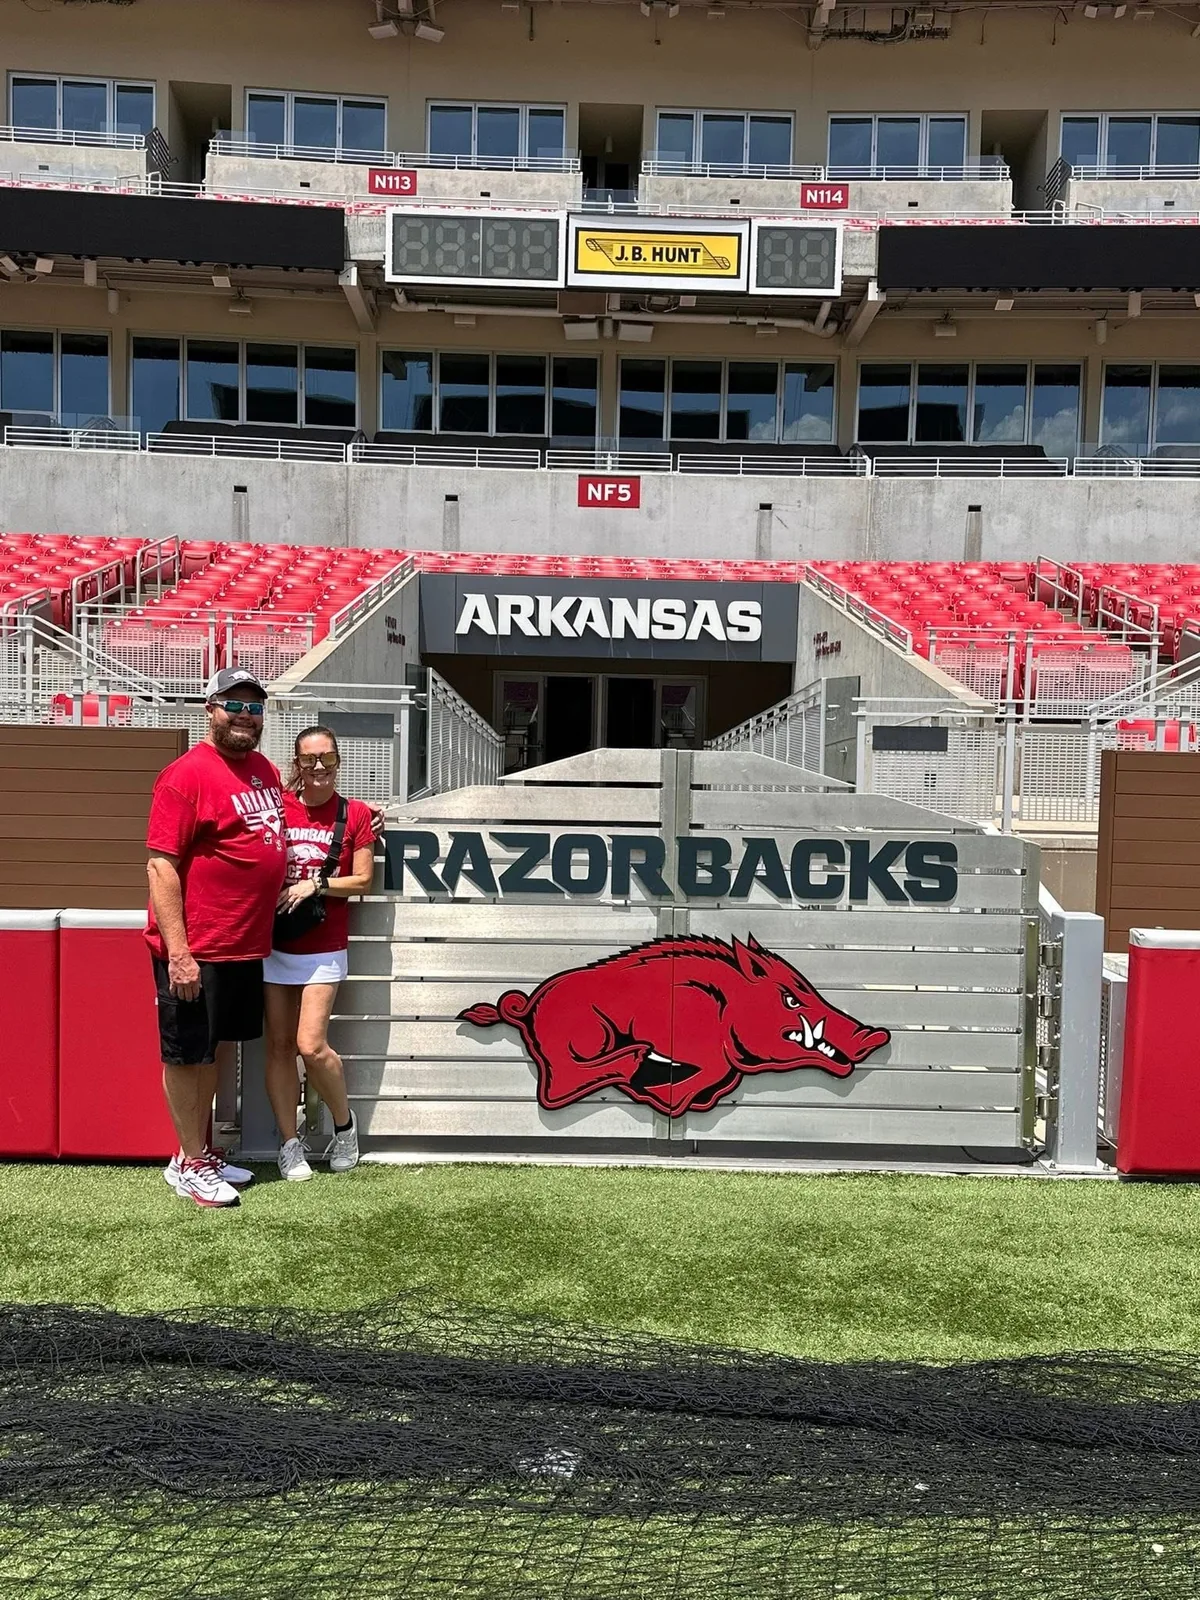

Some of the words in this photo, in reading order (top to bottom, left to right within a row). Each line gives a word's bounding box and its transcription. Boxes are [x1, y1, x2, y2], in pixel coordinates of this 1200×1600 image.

[375, 175, 411, 190] N113
[806, 189, 843, 204] N114
[615, 246, 628, 261] J.
[631, 246, 647, 262] B.
[652, 246, 701, 263] HUNT
[587, 483, 632, 502] NF5
[455, 593, 762, 642] ARKANSAS
[380, 829, 958, 903] RAZORBACKS
